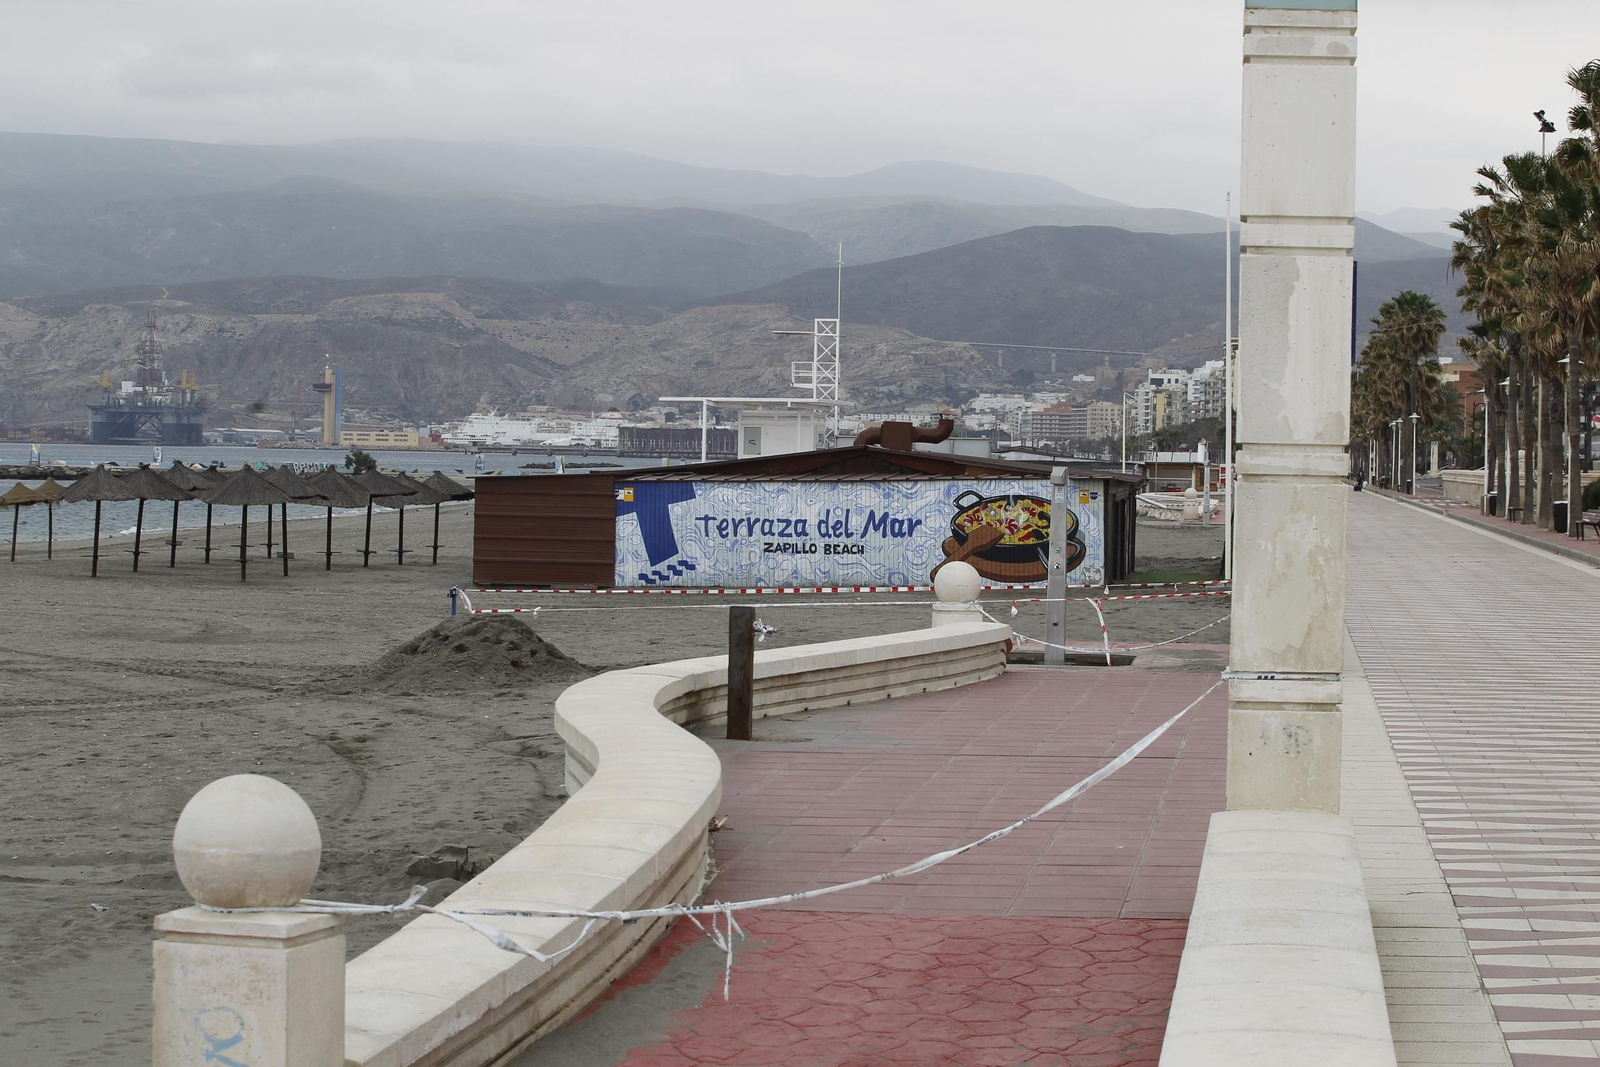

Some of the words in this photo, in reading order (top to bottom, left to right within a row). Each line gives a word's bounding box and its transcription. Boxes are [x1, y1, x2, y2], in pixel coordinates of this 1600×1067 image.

[695, 514, 809, 539] Terraza
[817, 508, 854, 539] del
[860, 509, 923, 539] Mar
[763, 542, 818, 555] ZAPILLO
[823, 543, 865, 555] BEACH
